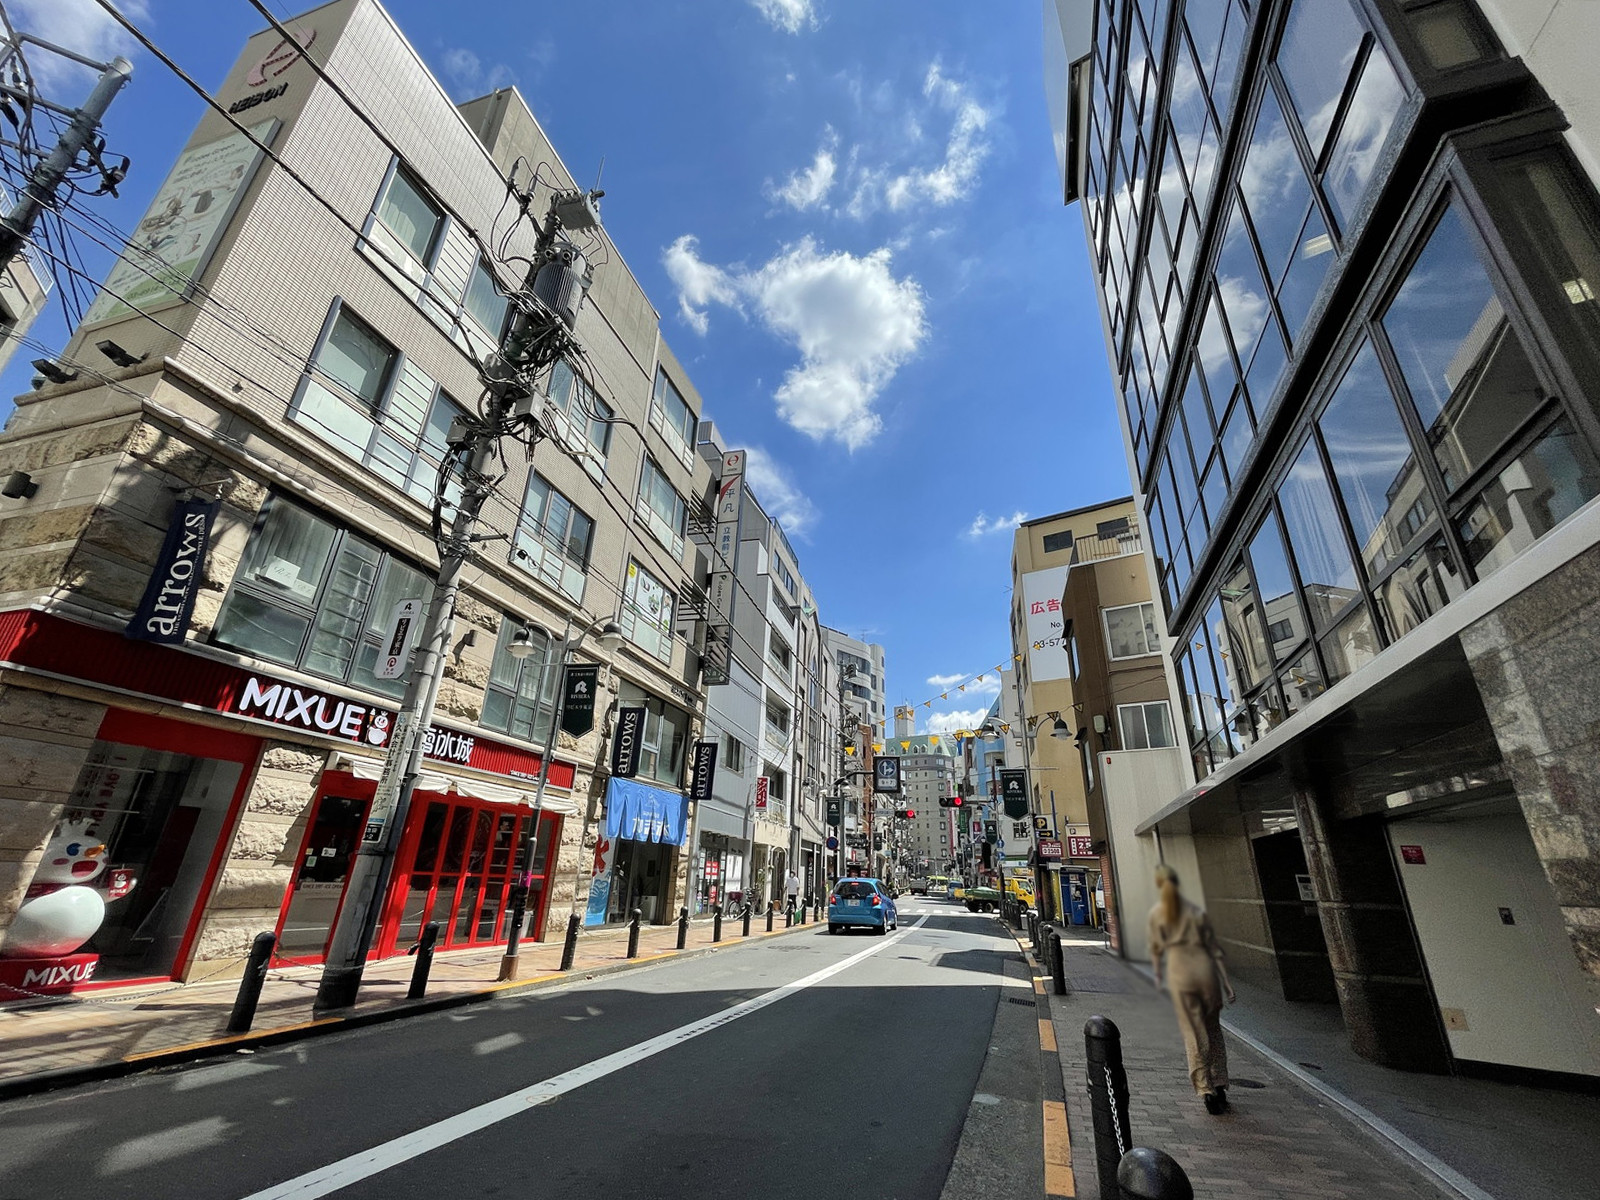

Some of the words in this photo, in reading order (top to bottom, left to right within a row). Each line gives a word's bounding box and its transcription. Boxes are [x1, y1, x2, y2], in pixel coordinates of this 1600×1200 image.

[723, 488, 736, 514] 平凡
[147, 513, 206, 636] arrows
[1031, 598, 1061, 615] 広告
[238, 677, 366, 737] MIXUE
[617, 712, 637, 774] arrows
[696, 746, 710, 797] arrows
[21, 961, 98, 987] MIXUE
